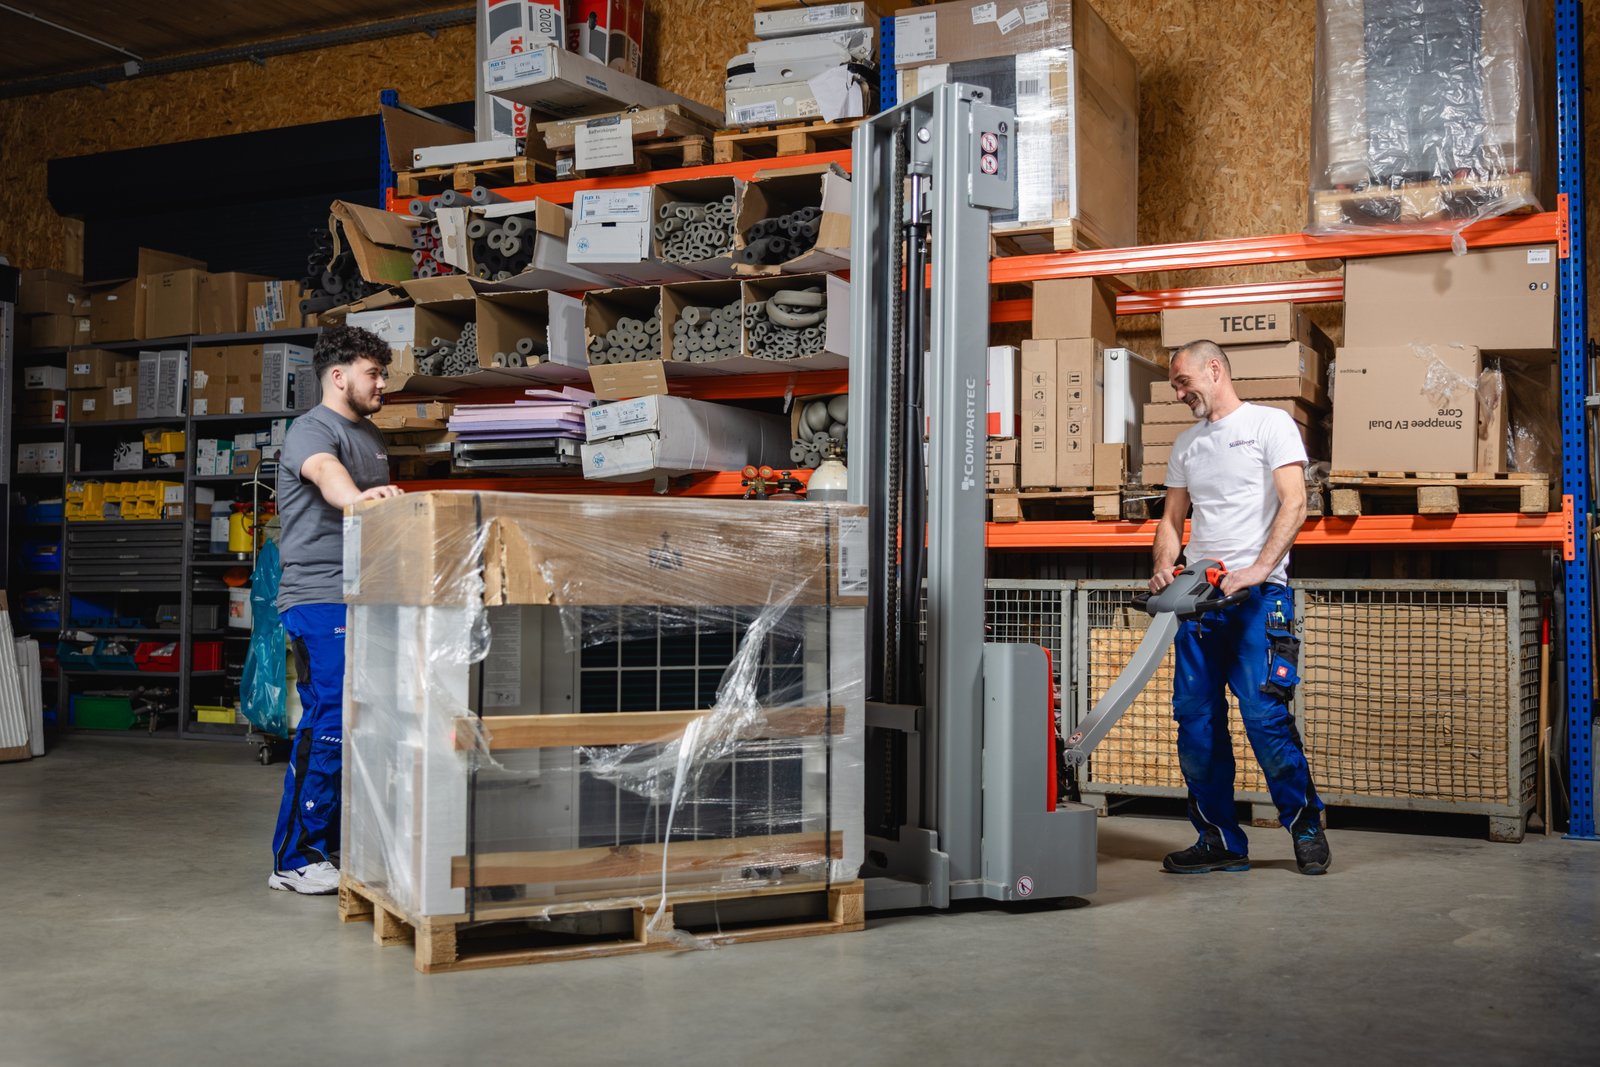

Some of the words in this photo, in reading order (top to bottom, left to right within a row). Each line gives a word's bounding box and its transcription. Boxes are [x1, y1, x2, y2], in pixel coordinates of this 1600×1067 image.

[539, 8, 552, 33] 02/02
[1219, 314, 1267, 332] TECE
[147, 362, 156, 411] SIMPLY
[167, 360, 177, 409] SIMPLY
[272, 353, 281, 404] SIMPLY
[1437, 408, 1463, 418] Core
[964, 378, 976, 476] COMPARTEC
[1369, 420, 1393, 430] Dual
[1394, 420, 1409, 430] EV
[1411, 418, 1463, 430] Smappee
